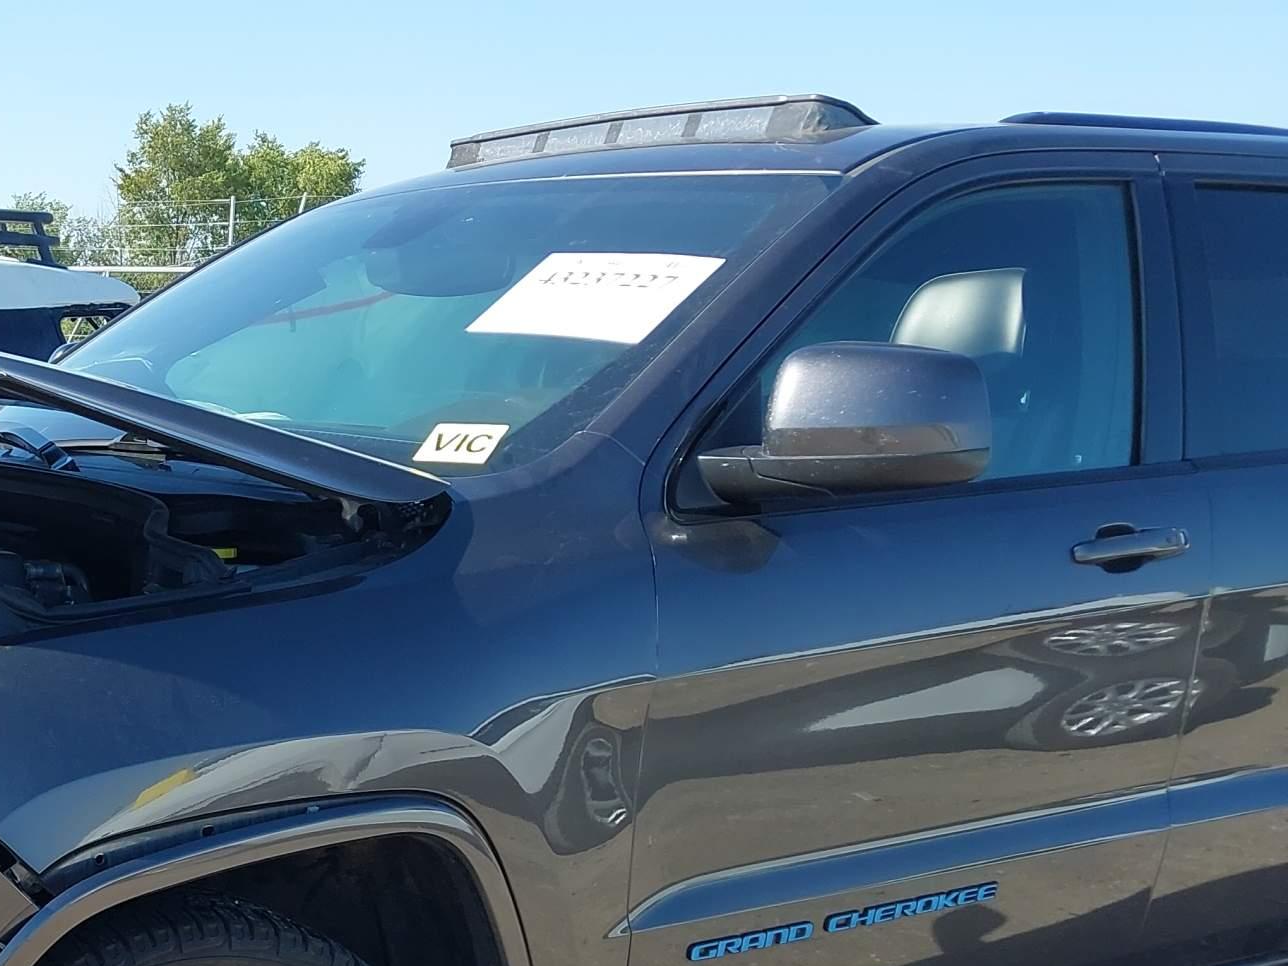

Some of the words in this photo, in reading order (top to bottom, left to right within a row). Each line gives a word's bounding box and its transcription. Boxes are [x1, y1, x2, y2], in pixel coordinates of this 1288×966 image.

[435, 433, 493, 453] VIC
[687, 920, 815, 961] GRAND
[823, 881, 999, 933] CHEROKEE
